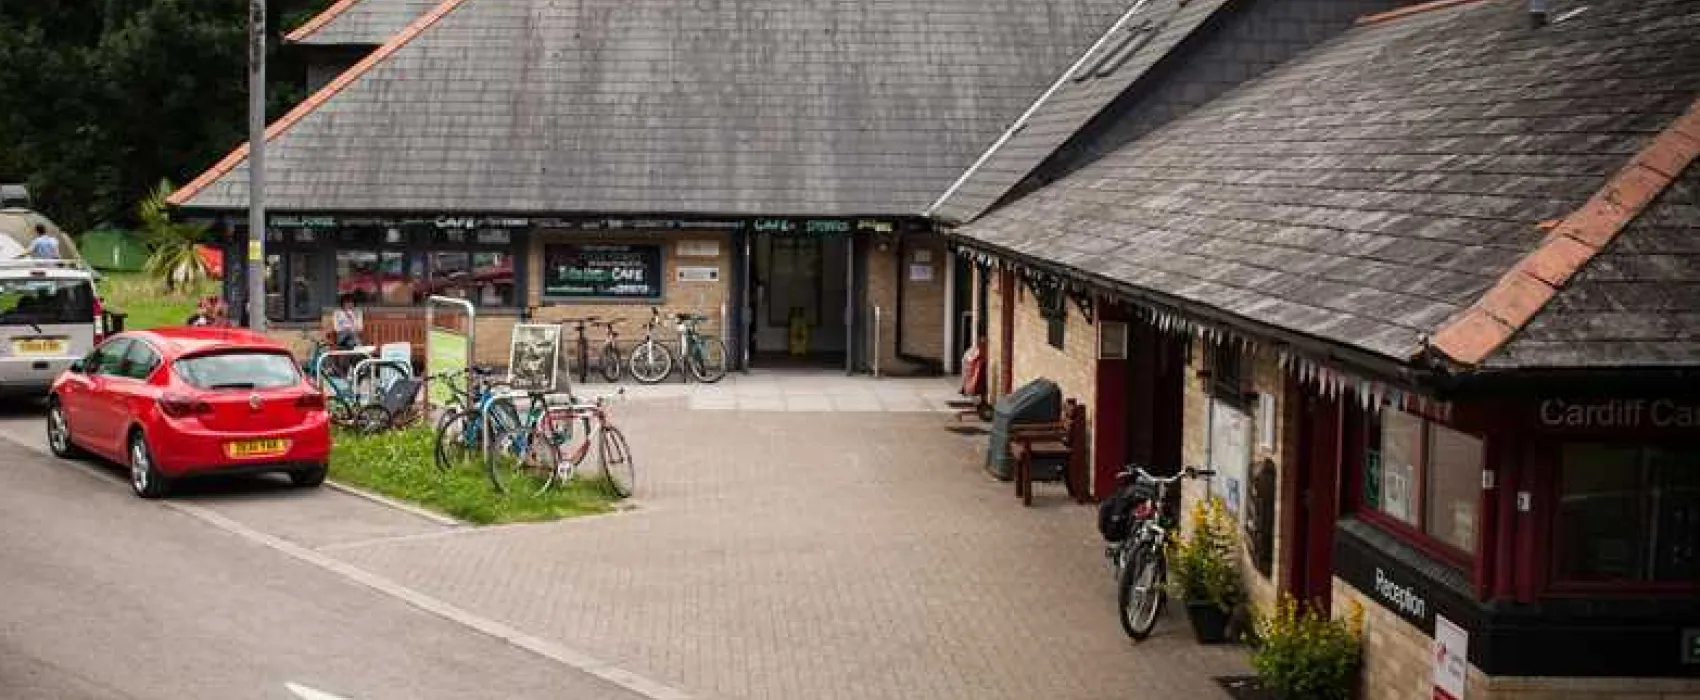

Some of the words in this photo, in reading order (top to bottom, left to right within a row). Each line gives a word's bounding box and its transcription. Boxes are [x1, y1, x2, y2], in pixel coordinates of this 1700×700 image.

[612, 267, 644, 280] CAFE
[1540, 398, 1645, 427] Cardiff
[1375, 567, 1425, 619] Reception
